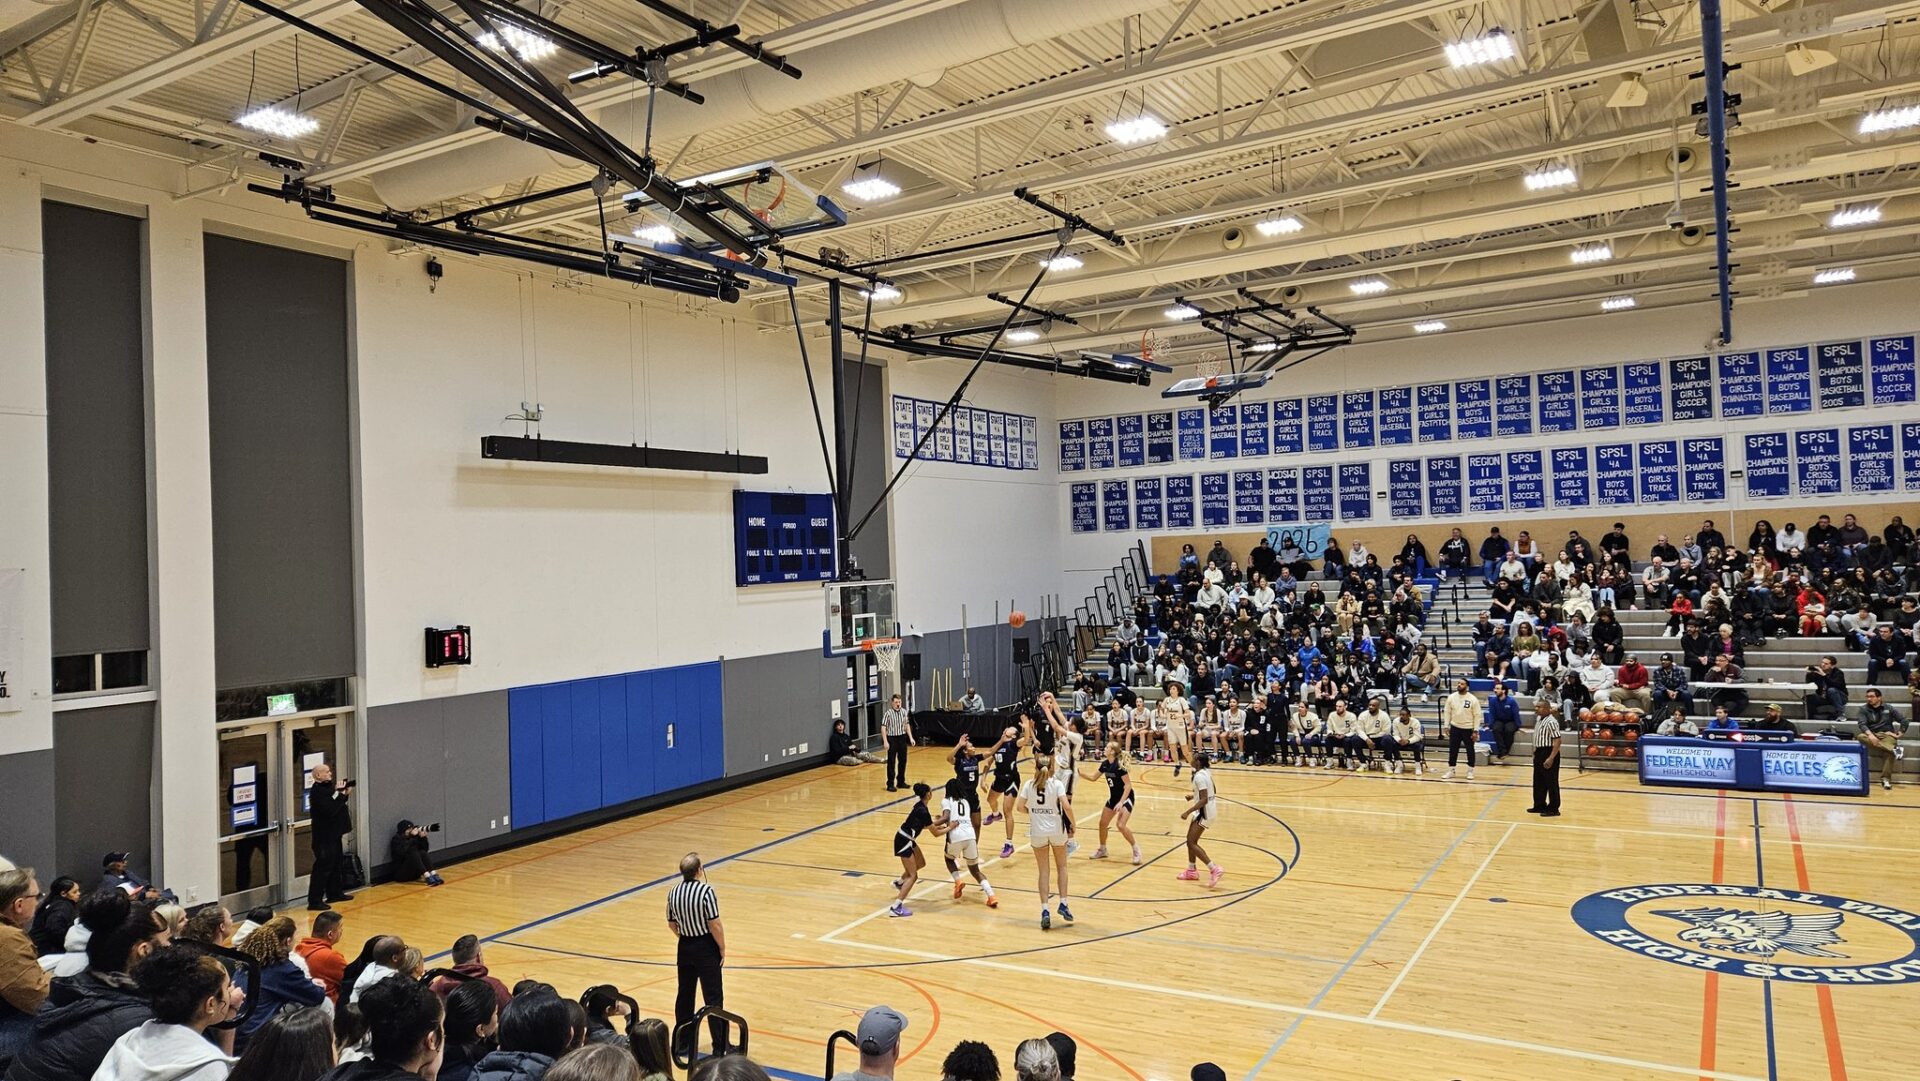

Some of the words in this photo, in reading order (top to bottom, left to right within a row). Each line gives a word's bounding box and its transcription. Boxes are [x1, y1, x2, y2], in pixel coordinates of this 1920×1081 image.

[1824, 345, 1856, 357] SPSL
[1876, 340, 1908, 352] SPSL
[1724, 355, 1754, 366] SPSL
[1773, 350, 1804, 362] SPSL
[1629, 366, 1656, 376] SPSL
[1677, 361, 1706, 372] SPSL
[1819, 365, 1862, 376] CHAMPIONS
[1872, 363, 1915, 373] CHAMPIONS
[1543, 374, 1569, 385] SPSL
[1586, 370, 1612, 380] SPSL
[1720, 375, 1761, 384] CHAMPIONS
[1768, 372, 1810, 382] CHAMPIONS
[1882, 374, 1905, 382] BOYS
[1500, 379, 1526, 389] SPSL
[1671, 380, 1711, 390] CHAMPIONS
[1830, 376, 1852, 385] BOYS
[1421, 386, 1445, 396] SPSL
[1460, 383, 1485, 393] SPSL
[1625, 385, 1662, 396] CHAMPIONS
[1729, 384, 1753, 393] GIRLS
[1778, 383, 1800, 391] BOYS
[1821, 384, 1864, 396] BASKETBALL
[1877, 384, 1912, 393] SOCCER
[1346, 394, 1370, 404] SPSL
[1383, 390, 1408, 400] SPSL
[1680, 390, 1703, 398] GIRLS
[1770, 392, 1810, 402] BASEBALL
[1310, 398, 1334, 407] SPSL
[1635, 396, 1652, 404] BOYS
[1677, 398, 1707, 408] SOCCER
[1822, 398, 1844, 407] 2005
[1875, 395, 1896, 404] 2007
[1244, 406, 1264, 414] SPSL
[1277, 402, 1299, 411] SPSL
[1546, 402, 1569, 410] GIRLS
[1626, 404, 1662, 413] BASEBALL
[1770, 404, 1791, 412] 2004
[1544, 410, 1571, 418] TENNIS
[1674, 411, 1694, 419] 2004
[1724, 407, 1744, 416] 2004
[1120, 418, 1139, 426] SPSL
[1151, 415, 1169, 423] SPSL
[1585, 418, 1603, 426] 2003
[1627, 416, 1645, 424] 2003
[1091, 421, 1110, 429] SPSL
[1800, 432, 1834, 444] SPSL
[1853, 429, 1889, 441] SPSL
[1689, 441, 1719, 452] SPSL
[1749, 436, 1783, 448] SPSL
[1600, 448, 1627, 459] SPSL
[1644, 444, 1672, 455] SPSL
[1511, 454, 1537, 464] SPSL
[1556, 450, 1582, 461] SPSL
[1798, 455, 1840, 464] CHAMPIONS
[1850, 452, 1893, 461] CHAMPIONS
[1431, 460, 1457, 470] SPSL
[1470, 456, 1500, 466] REGION
[1747, 457, 1788, 467] CHAMPIONS
[1342, 466, 1365, 476] SPSL
[1393, 463, 1417, 473] SPSL
[1640, 465, 1678, 474] CHAMPIONS
[1685, 462, 1724, 471] CHAMPIONS
[1809, 463, 1830, 471] BOYS
[1236, 473, 1255, 481] SPSL
[1306, 469, 1329, 478] SPSL
[1597, 471, 1633, 479] CHAMPIONS
[1748, 467, 1788, 477] FOOTBALL
[1169, 479, 1190, 487] SPSL
[1204, 476, 1225, 485] SPSL
[1561, 480, 1582, 488] GIRLS
[1648, 475, 1671, 483] GIRLS
[1121, 482, 1126, 490] C
[1687, 492, 1704, 500] 2014
[748, 517, 766, 527] HOME
[811, 518, 828, 527] GUEST
[445, 633, 462, 657] 17
[1646, 755, 1701, 768] FEDERAL
[1703, 757, 1734, 769] WAY
[1764, 760, 1822, 776] EAGLES
[969, 772, 975, 781] 5
[1108, 778, 1114, 787] 3
[1037, 790, 1045, 804] 5
[958, 802, 964, 816] 0
[1602, 884, 1827, 904] FEDERAL
[1595, 928, 1730, 969] HIGH
[1743, 958, 1920, 983] SCHOO
